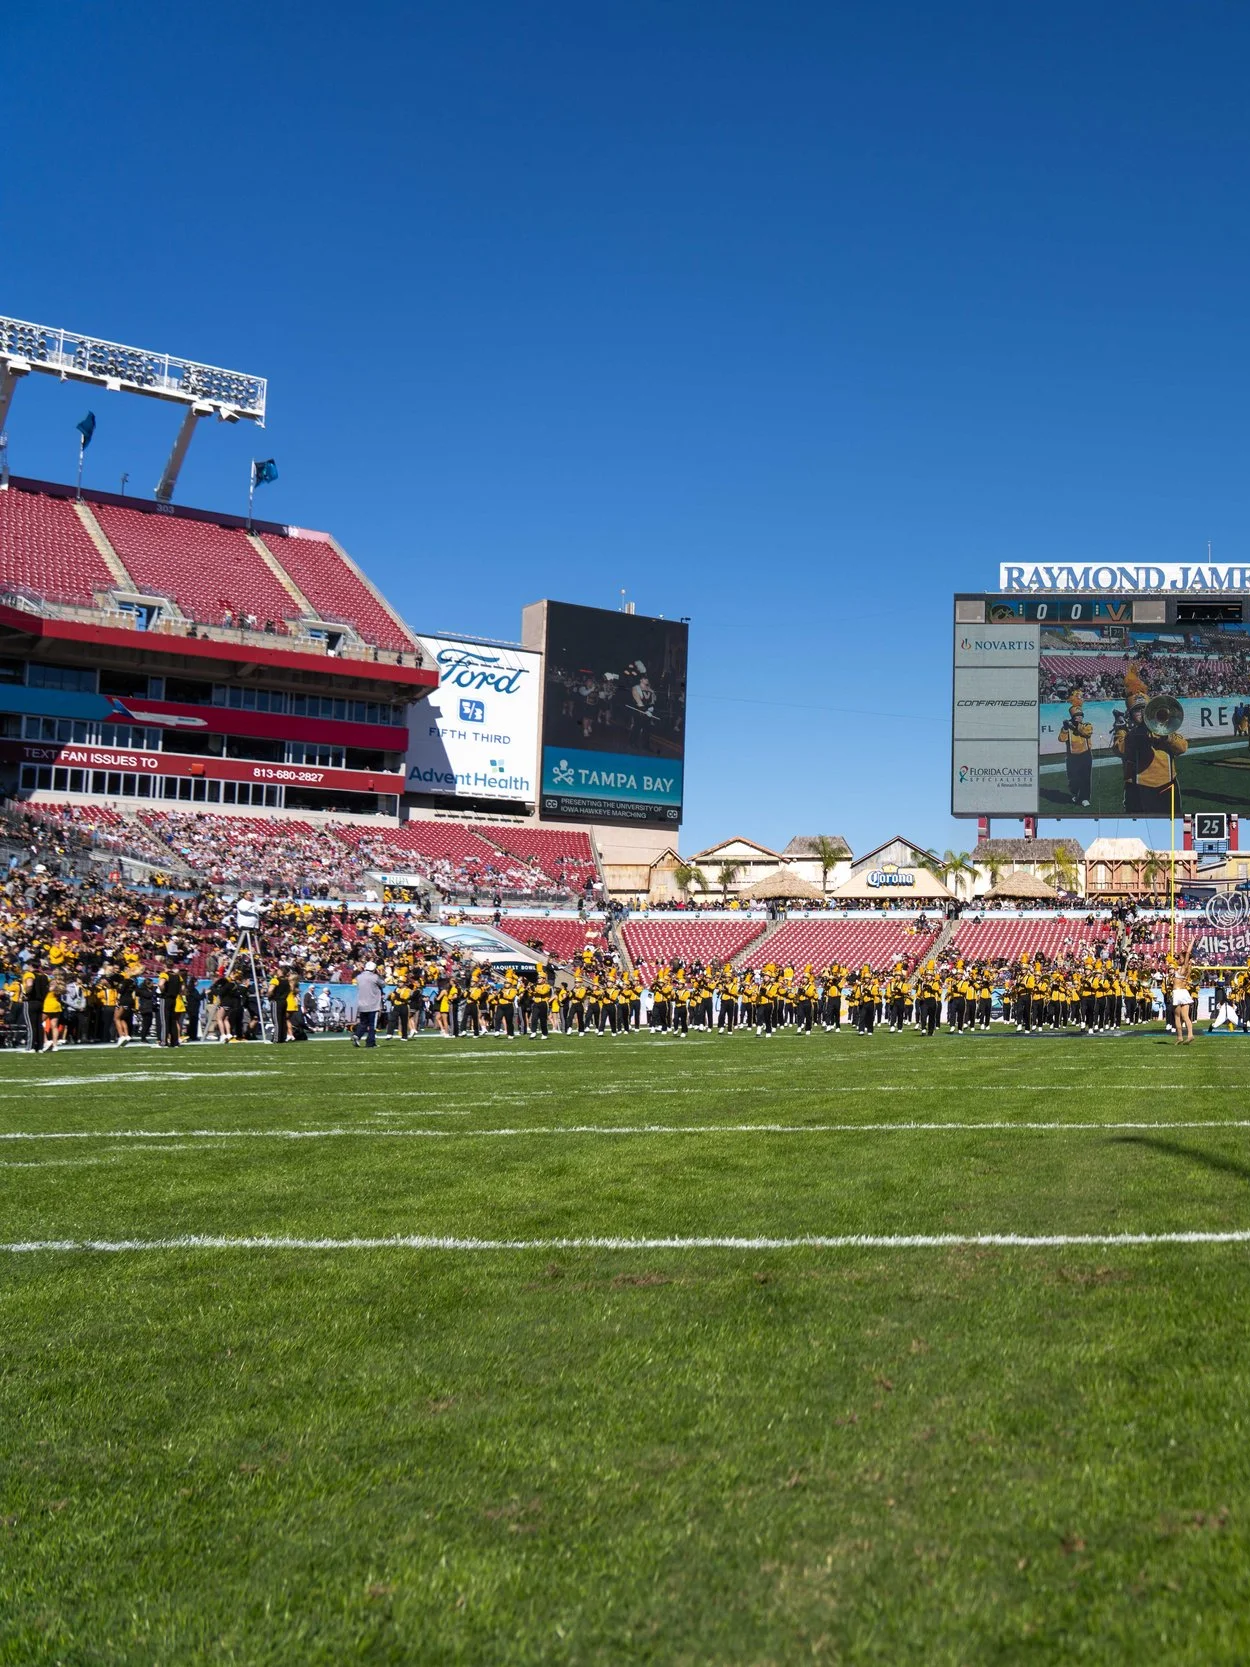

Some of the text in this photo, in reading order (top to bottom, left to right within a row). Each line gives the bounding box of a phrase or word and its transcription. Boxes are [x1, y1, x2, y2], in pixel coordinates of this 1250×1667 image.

[156, 503, 175, 514] 303
[1004, 565, 1166, 591] RAYMOND
[1036, 603, 1048, 620] 0
[1071, 603, 1082, 620] 0
[975, 640, 1035, 650] NOVARTIS
[436, 648, 521, 694] Ford
[429, 727, 511, 745] FIFTH THIRD
[24, 747, 158, 769] TEXT FAN ISSUES TO
[253, 767, 324, 783] 813-680-2827
[408, 766, 530, 791] AdventHealth
[970, 767, 1033, 776] FLORIDA CANCER
[578, 769, 674, 793] TAMPA BAY
[561, 798, 602, 808] PRESENTING
[616, 803, 653, 812] UNIVERSITY
[579, 808, 611, 816] HAWKEYE
[611, 810, 647, 819] MARCHING
[1202, 819, 1219, 834] 25
[866, 870, 915, 888] Corona
